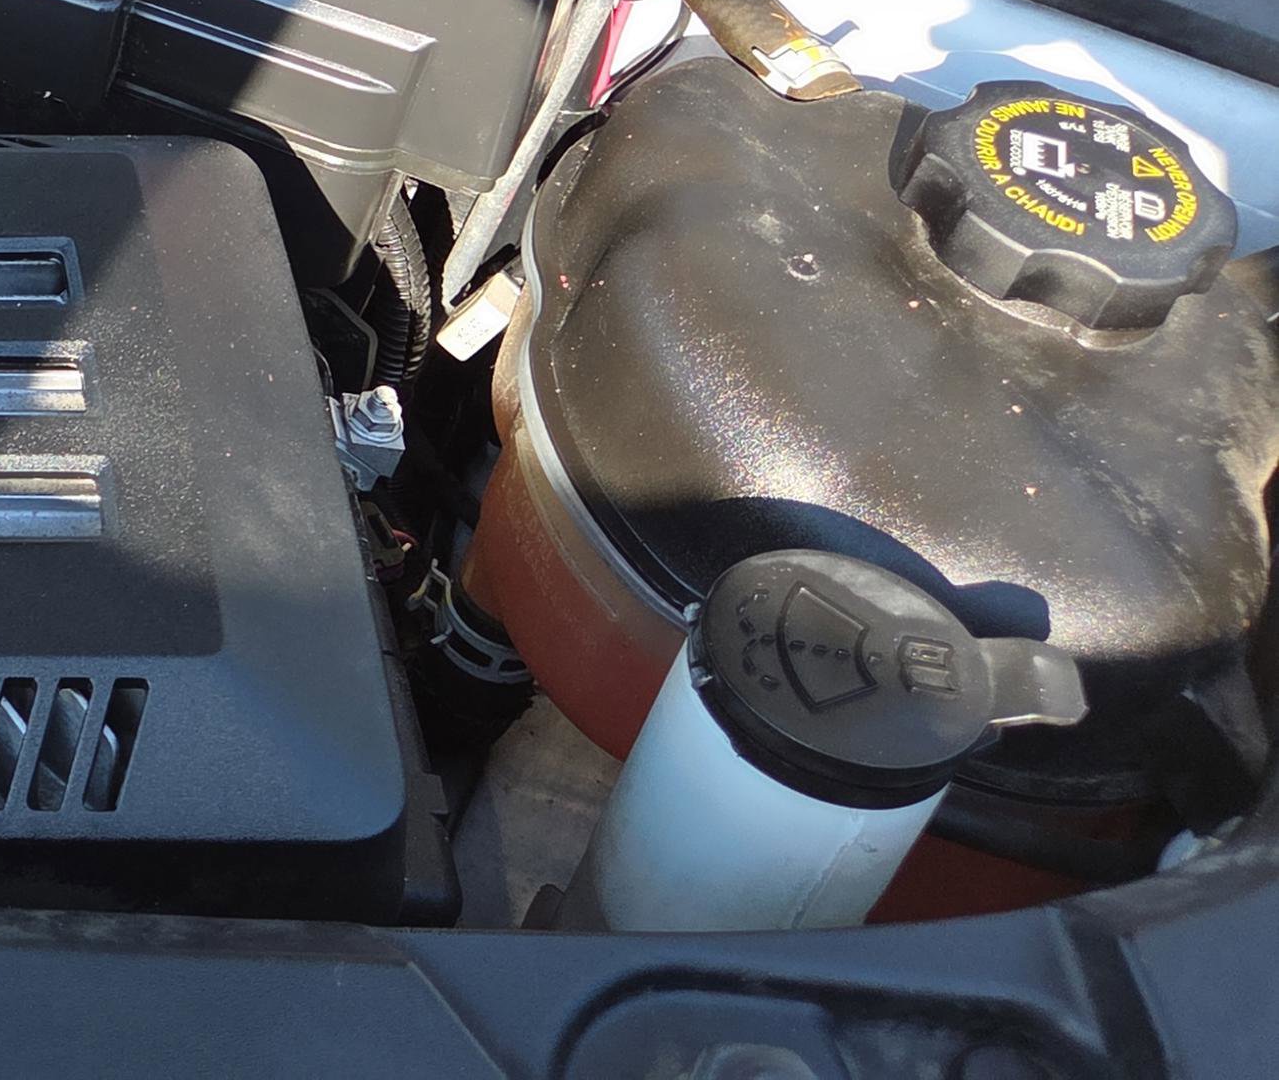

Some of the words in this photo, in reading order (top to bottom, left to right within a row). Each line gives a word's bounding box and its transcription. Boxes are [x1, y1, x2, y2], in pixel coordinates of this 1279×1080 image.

[990, 99, 1050, 122] JAMAIS
[1054, 102, 1085, 119] NE
[975, 119, 1002, 170] OUVRIR
[1148, 147, 1192, 191] NEVER
[1171, 191, 1197, 225] OPEN
